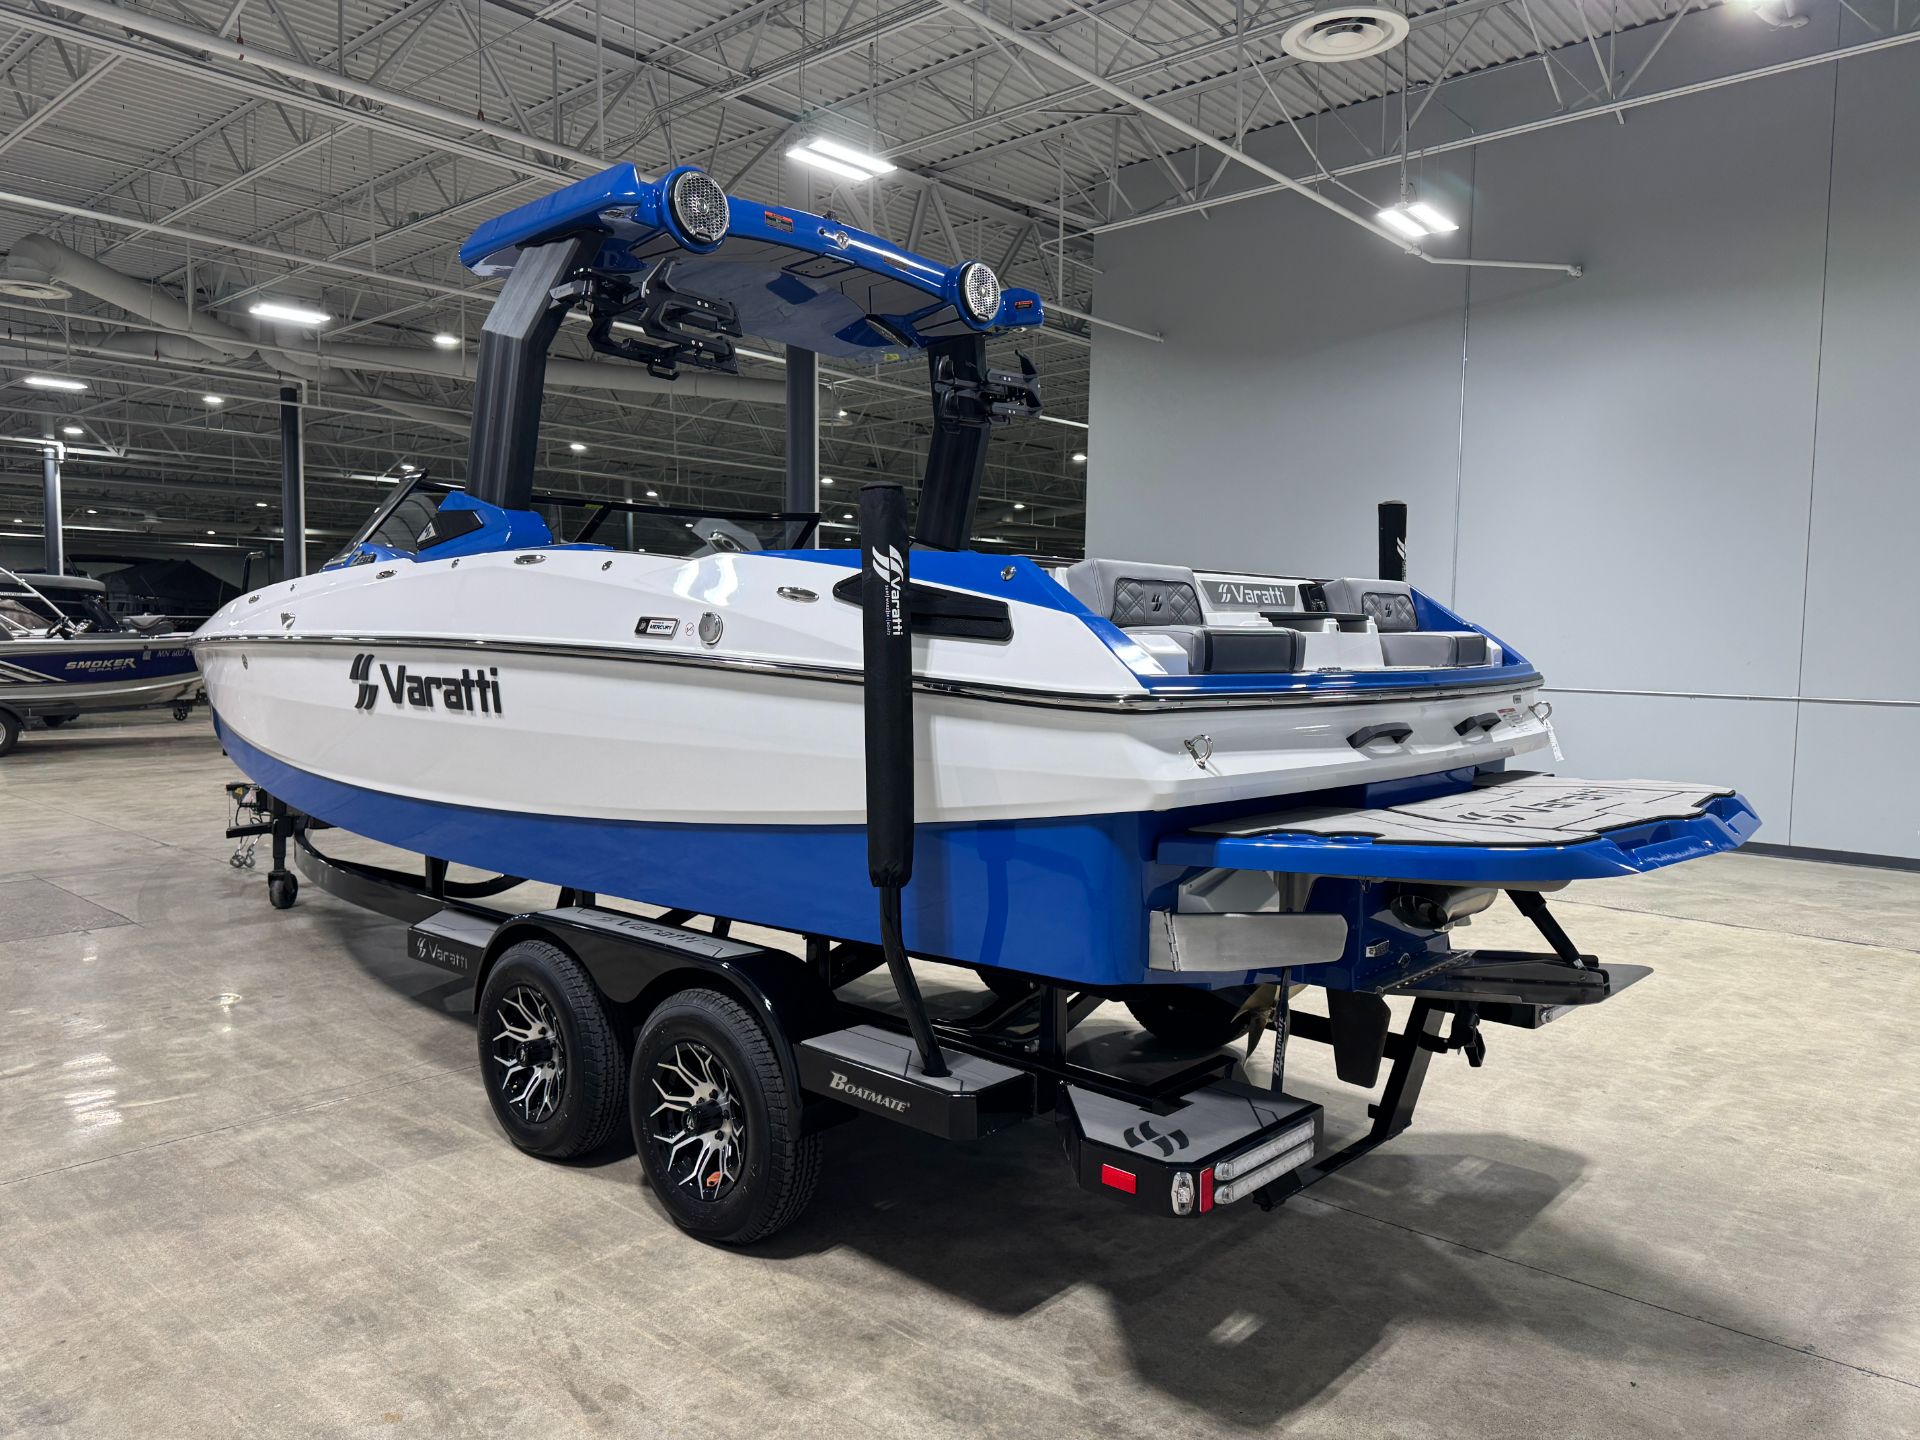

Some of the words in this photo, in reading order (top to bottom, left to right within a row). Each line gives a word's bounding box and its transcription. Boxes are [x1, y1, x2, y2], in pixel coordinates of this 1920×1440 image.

[890, 576, 904, 636] Varatti
[1230, 584, 1287, 605] Varatti
[64, 657, 136, 670] SMOKER
[380, 663, 502, 714] Varatti
[1489, 788, 1632, 813] Varatti
[616, 919, 707, 944] Varatti
[428, 940, 468, 969] Varatti
